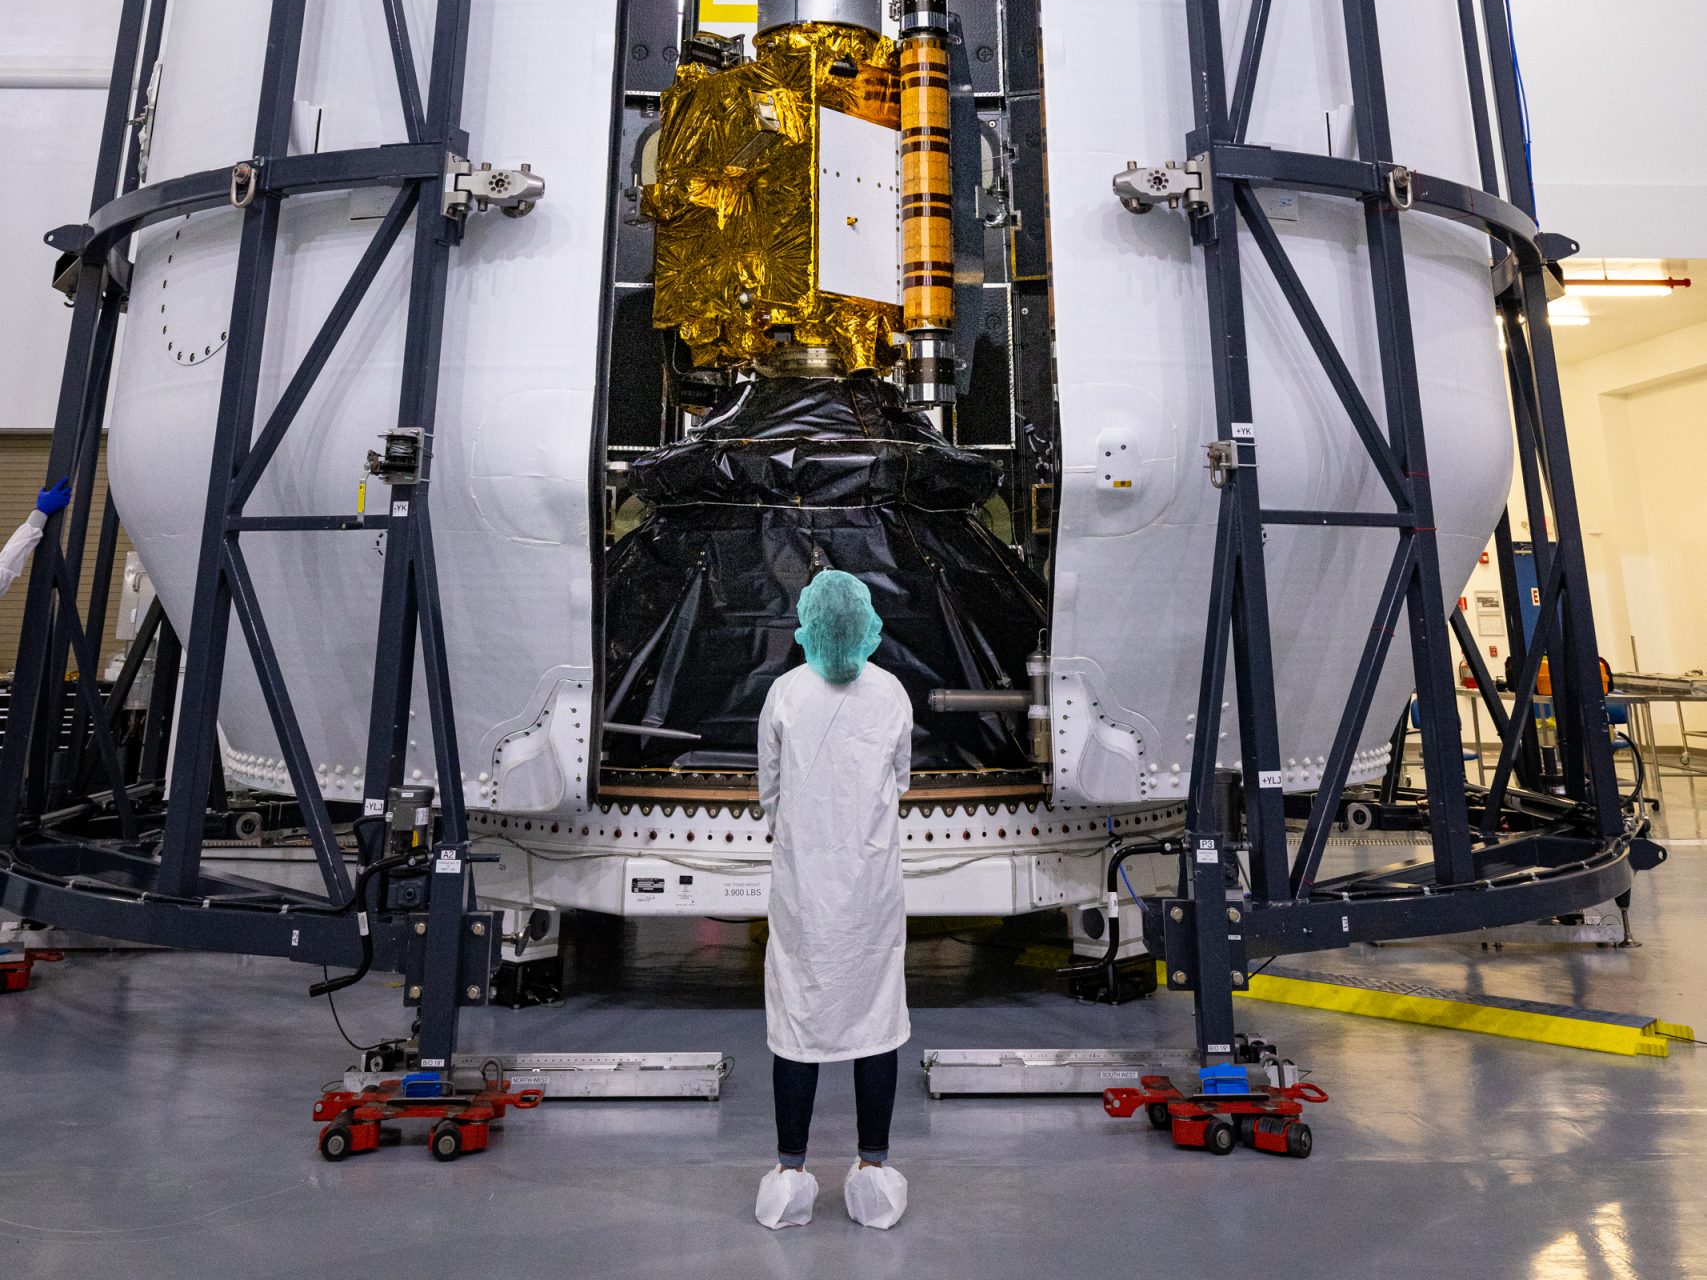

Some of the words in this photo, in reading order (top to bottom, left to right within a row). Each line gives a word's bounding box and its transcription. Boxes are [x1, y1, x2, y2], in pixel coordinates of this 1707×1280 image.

[1262, 776, 1282, 784] +YLJ
[366, 803, 383, 811] -YLJ
[1201, 840, 1213, 849] P3
[443, 850, 454, 859] A2
